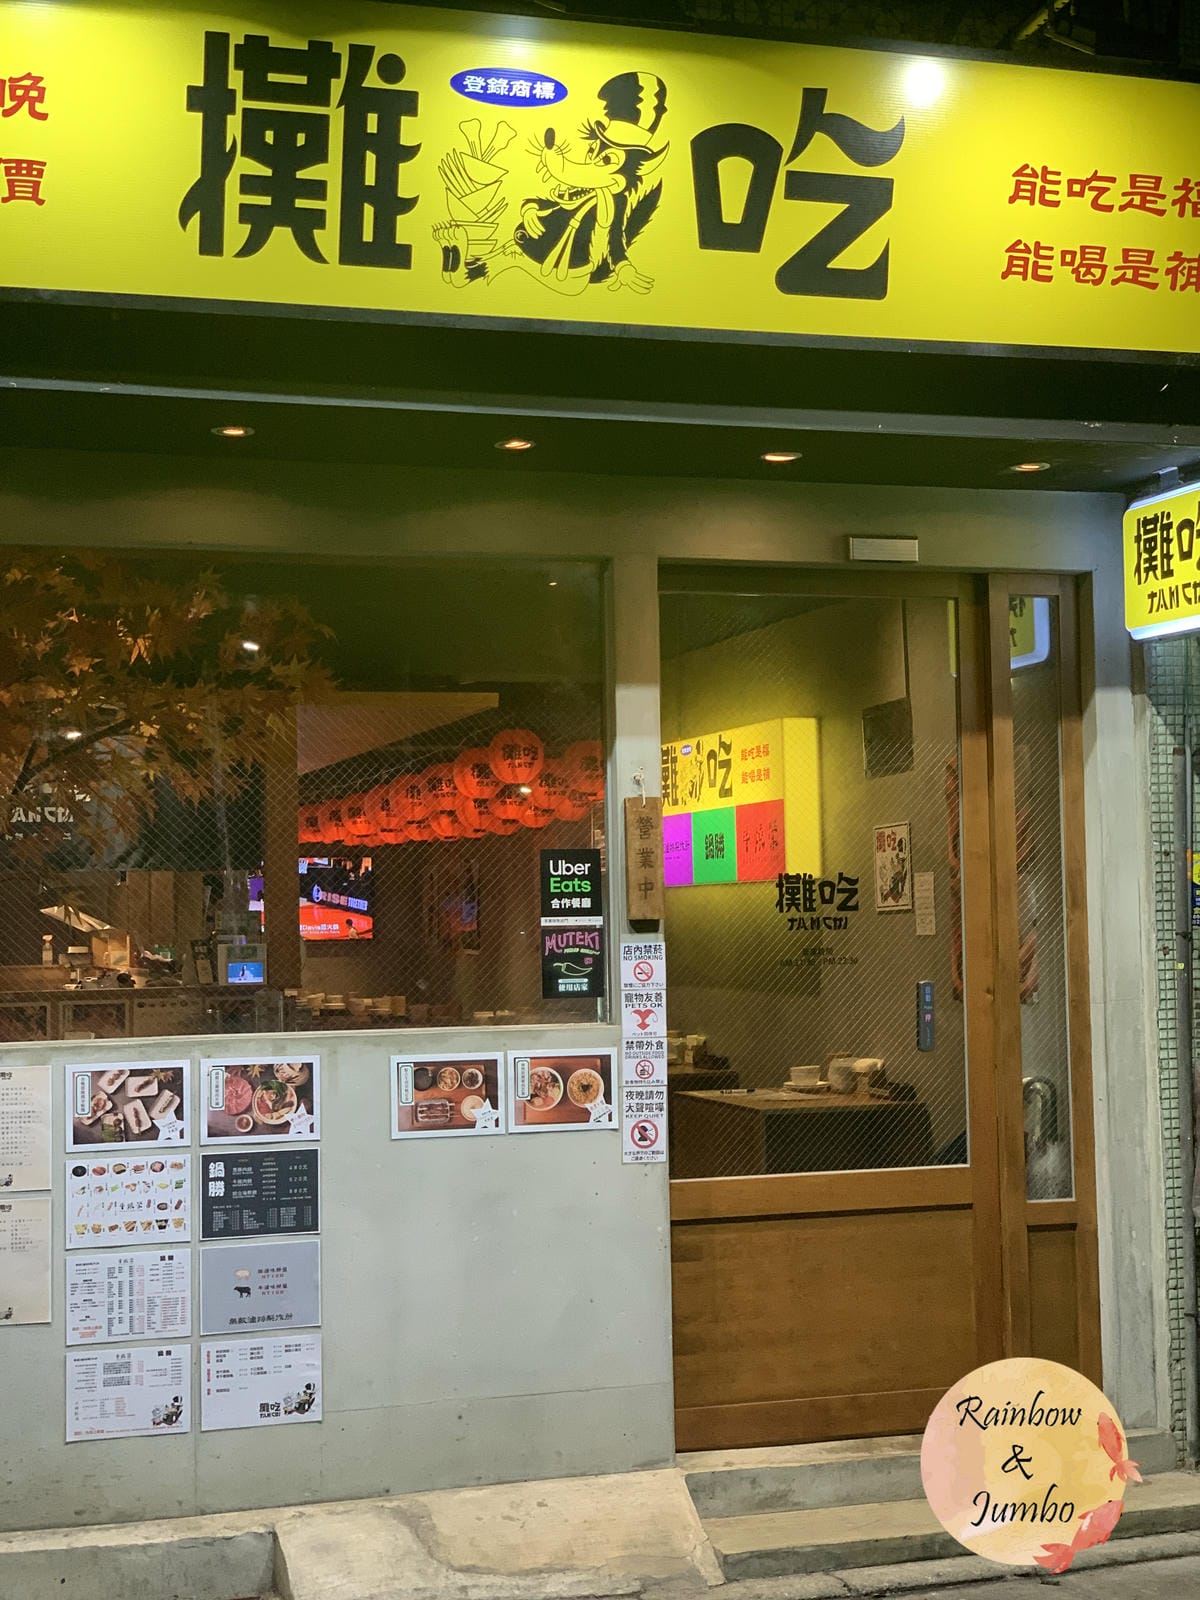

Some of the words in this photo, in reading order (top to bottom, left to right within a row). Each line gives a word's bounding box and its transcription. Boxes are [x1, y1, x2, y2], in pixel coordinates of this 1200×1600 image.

[463, 75, 556, 100] 登錄商標
[690, 88, 905, 300] 吃
[549, 859, 591, 876] Uber
[635, 815, 655, 900] 營業中
[549, 877, 591, 893] Eats
[775, 872, 860, 913] 攤吃
[544, 931, 600, 956] MUTEKI
[623, 944, 663, 955] 店內禁菸
[625, 1040, 664, 1051] 禁帶外食
[625, 1090, 664, 1101] 夜晚請勿
[208, 1161, 225, 1198] 鍋勝
